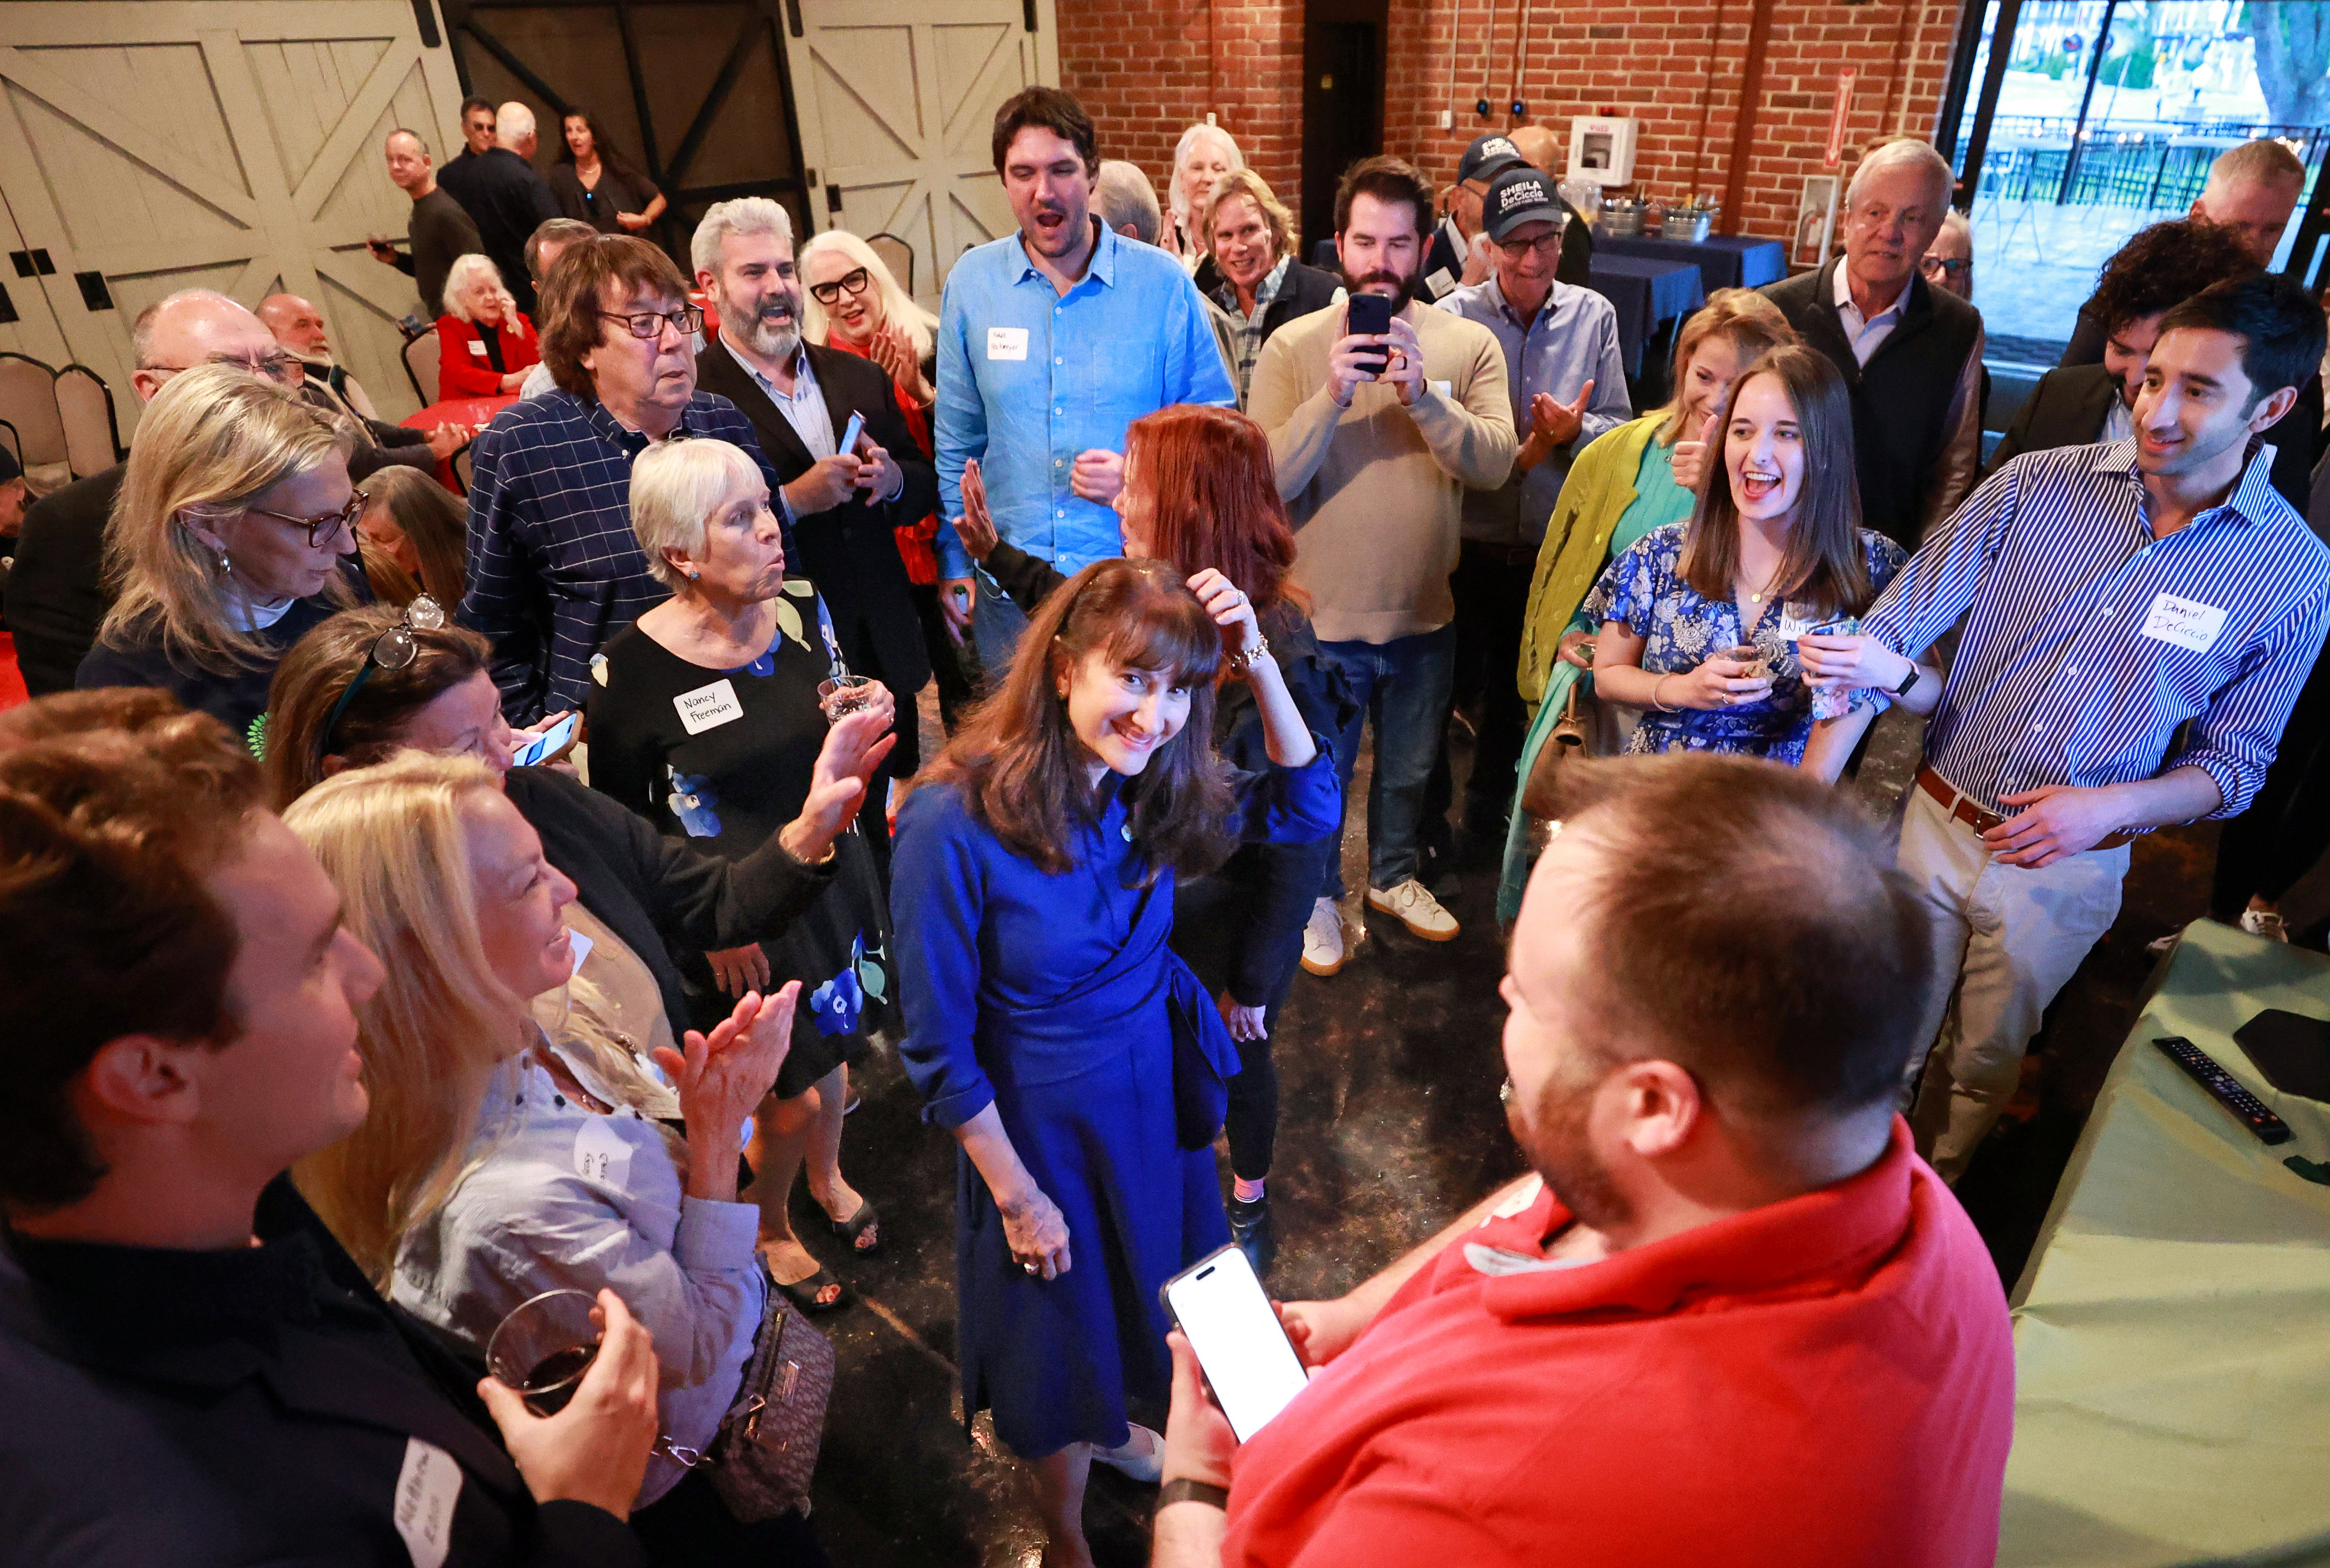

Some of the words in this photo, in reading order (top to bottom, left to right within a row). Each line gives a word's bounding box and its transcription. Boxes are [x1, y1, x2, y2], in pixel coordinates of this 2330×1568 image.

[1500, 180, 1541, 198] SHEILA
[1501, 189, 1544, 208] DeCiccio
[2163, 600, 2206, 620] Daniel
[2154, 616, 2208, 641] DeCiccio
[683, 692, 715, 709] Nancy
[690, 703, 732, 723] Freeman
